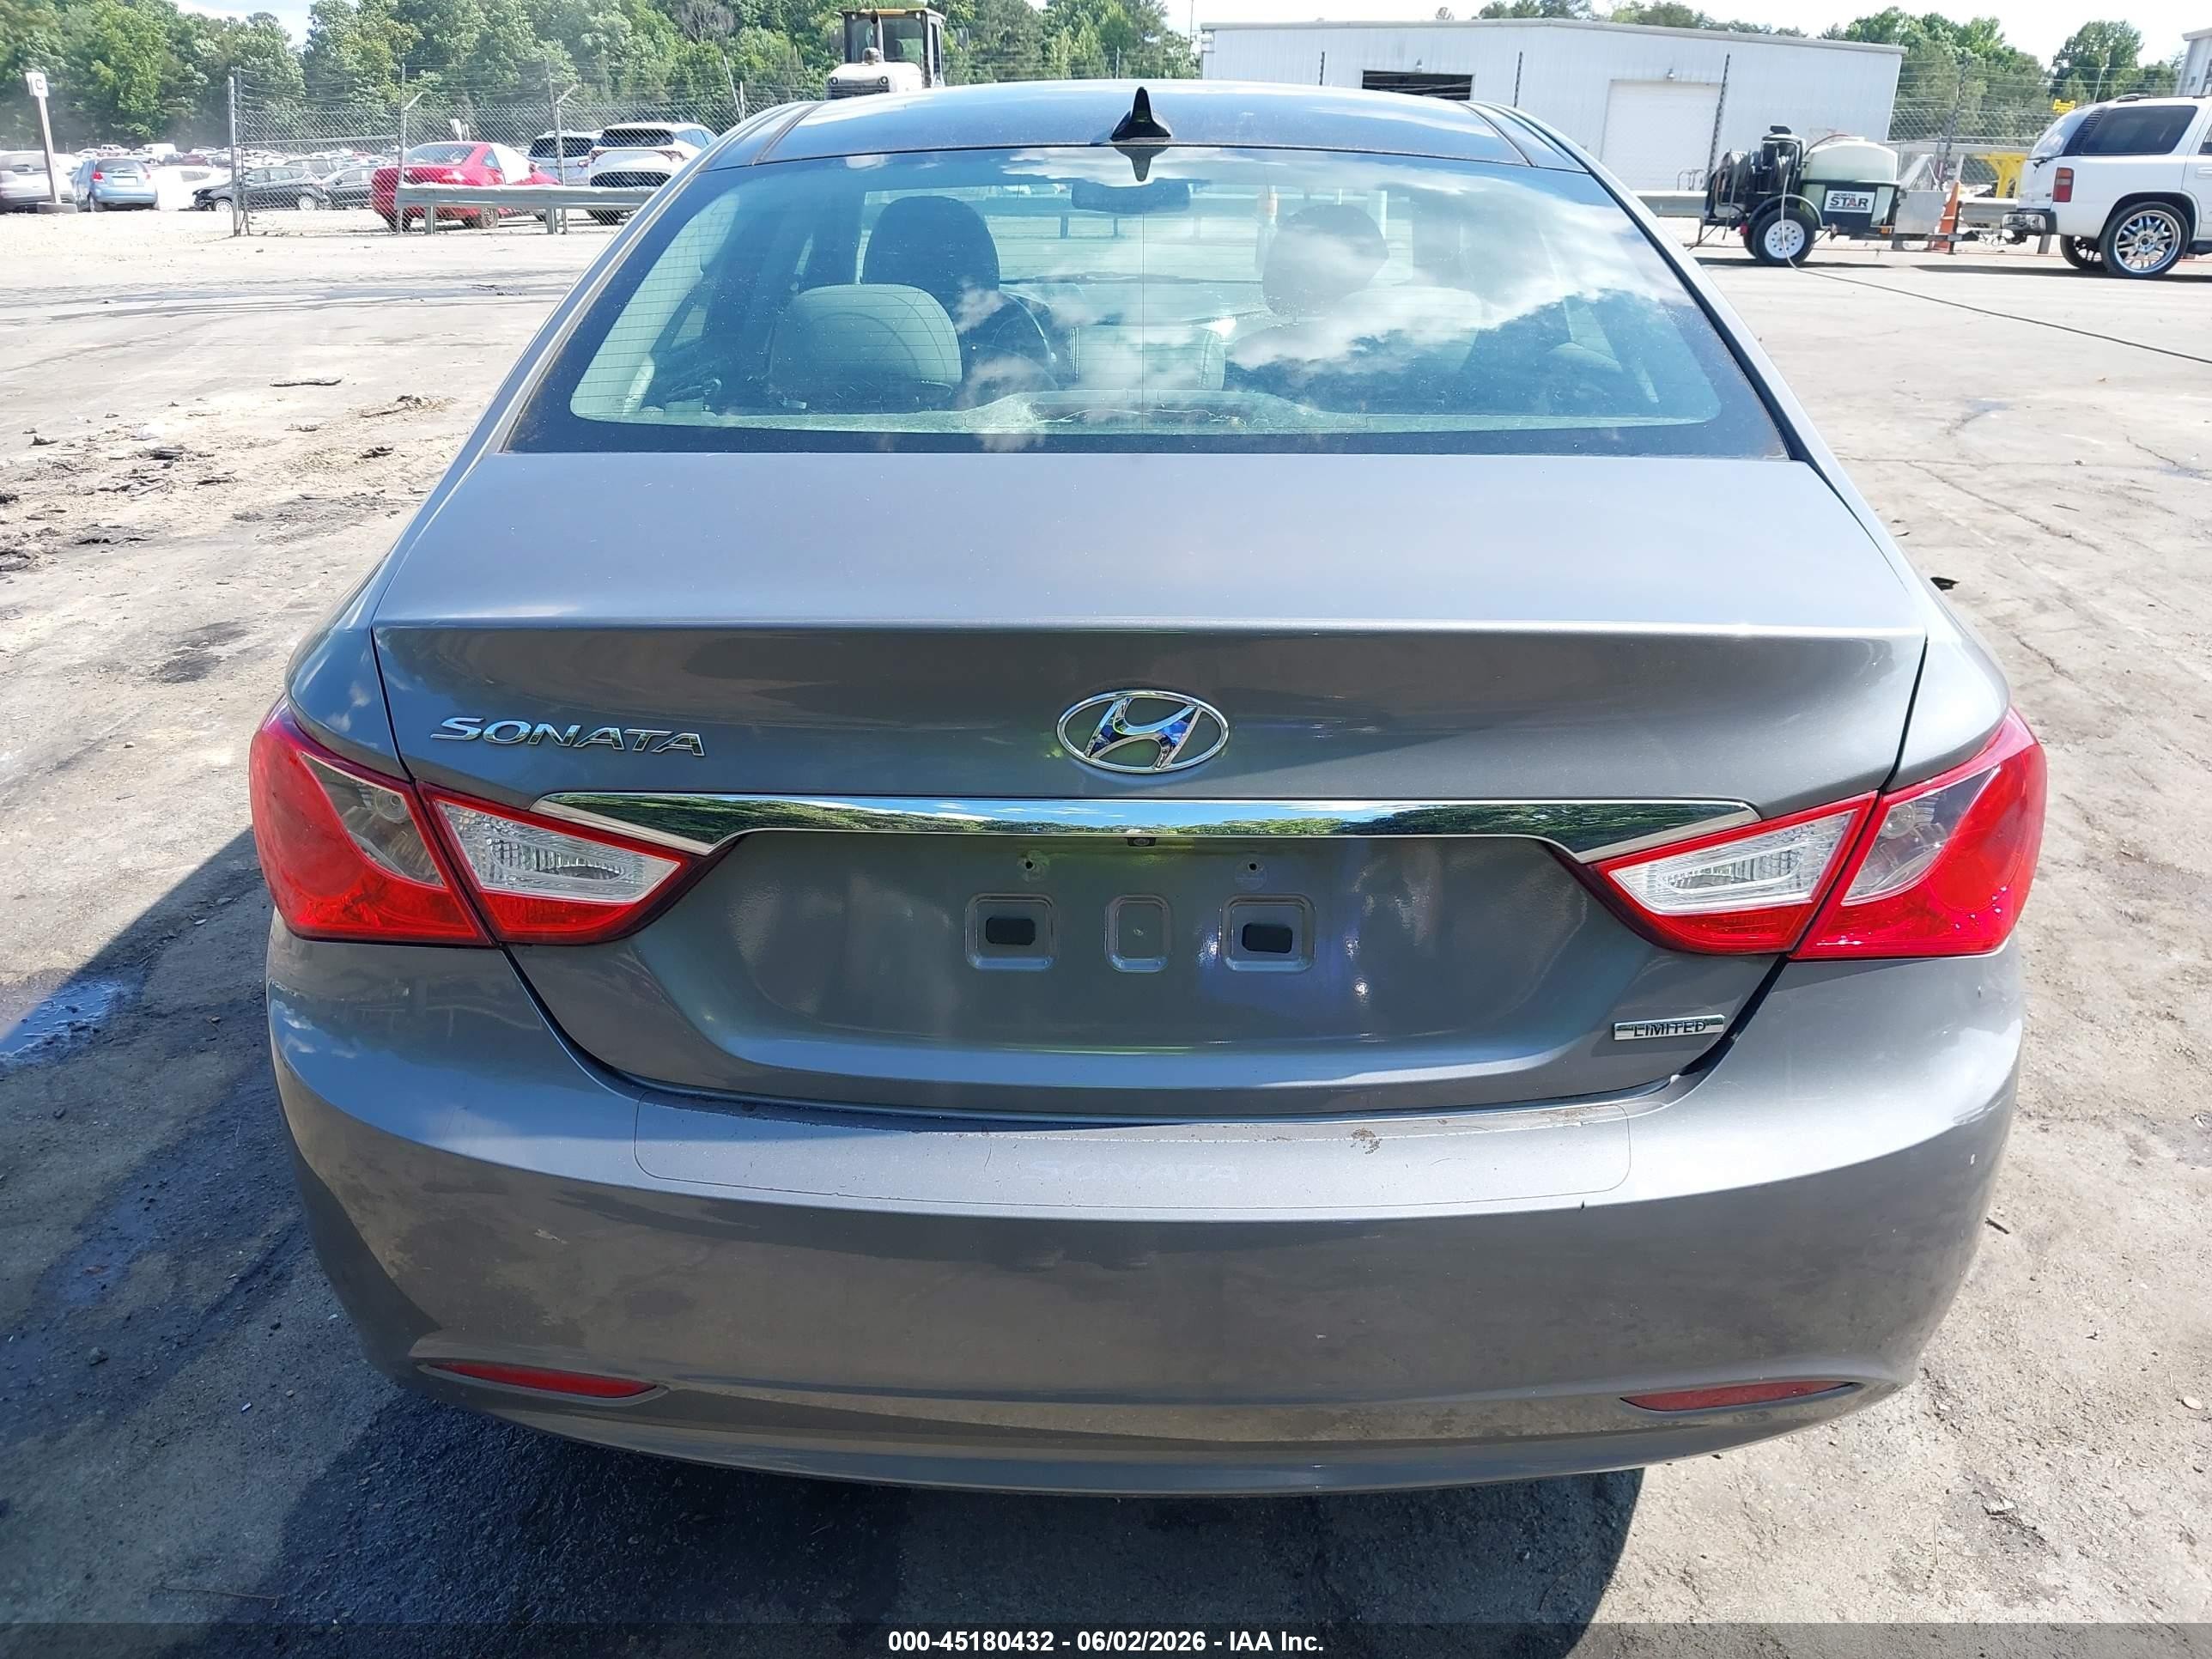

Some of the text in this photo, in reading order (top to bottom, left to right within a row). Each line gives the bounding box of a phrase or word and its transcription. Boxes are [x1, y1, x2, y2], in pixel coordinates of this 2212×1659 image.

[35, 79, 44, 90] C
[1829, 196, 1869, 207] STAR
[429, 716, 706, 757] SONATA
[1633, 1021, 1706, 1037] LIMITED
[1019, 1159, 1240, 1183] SONATA
